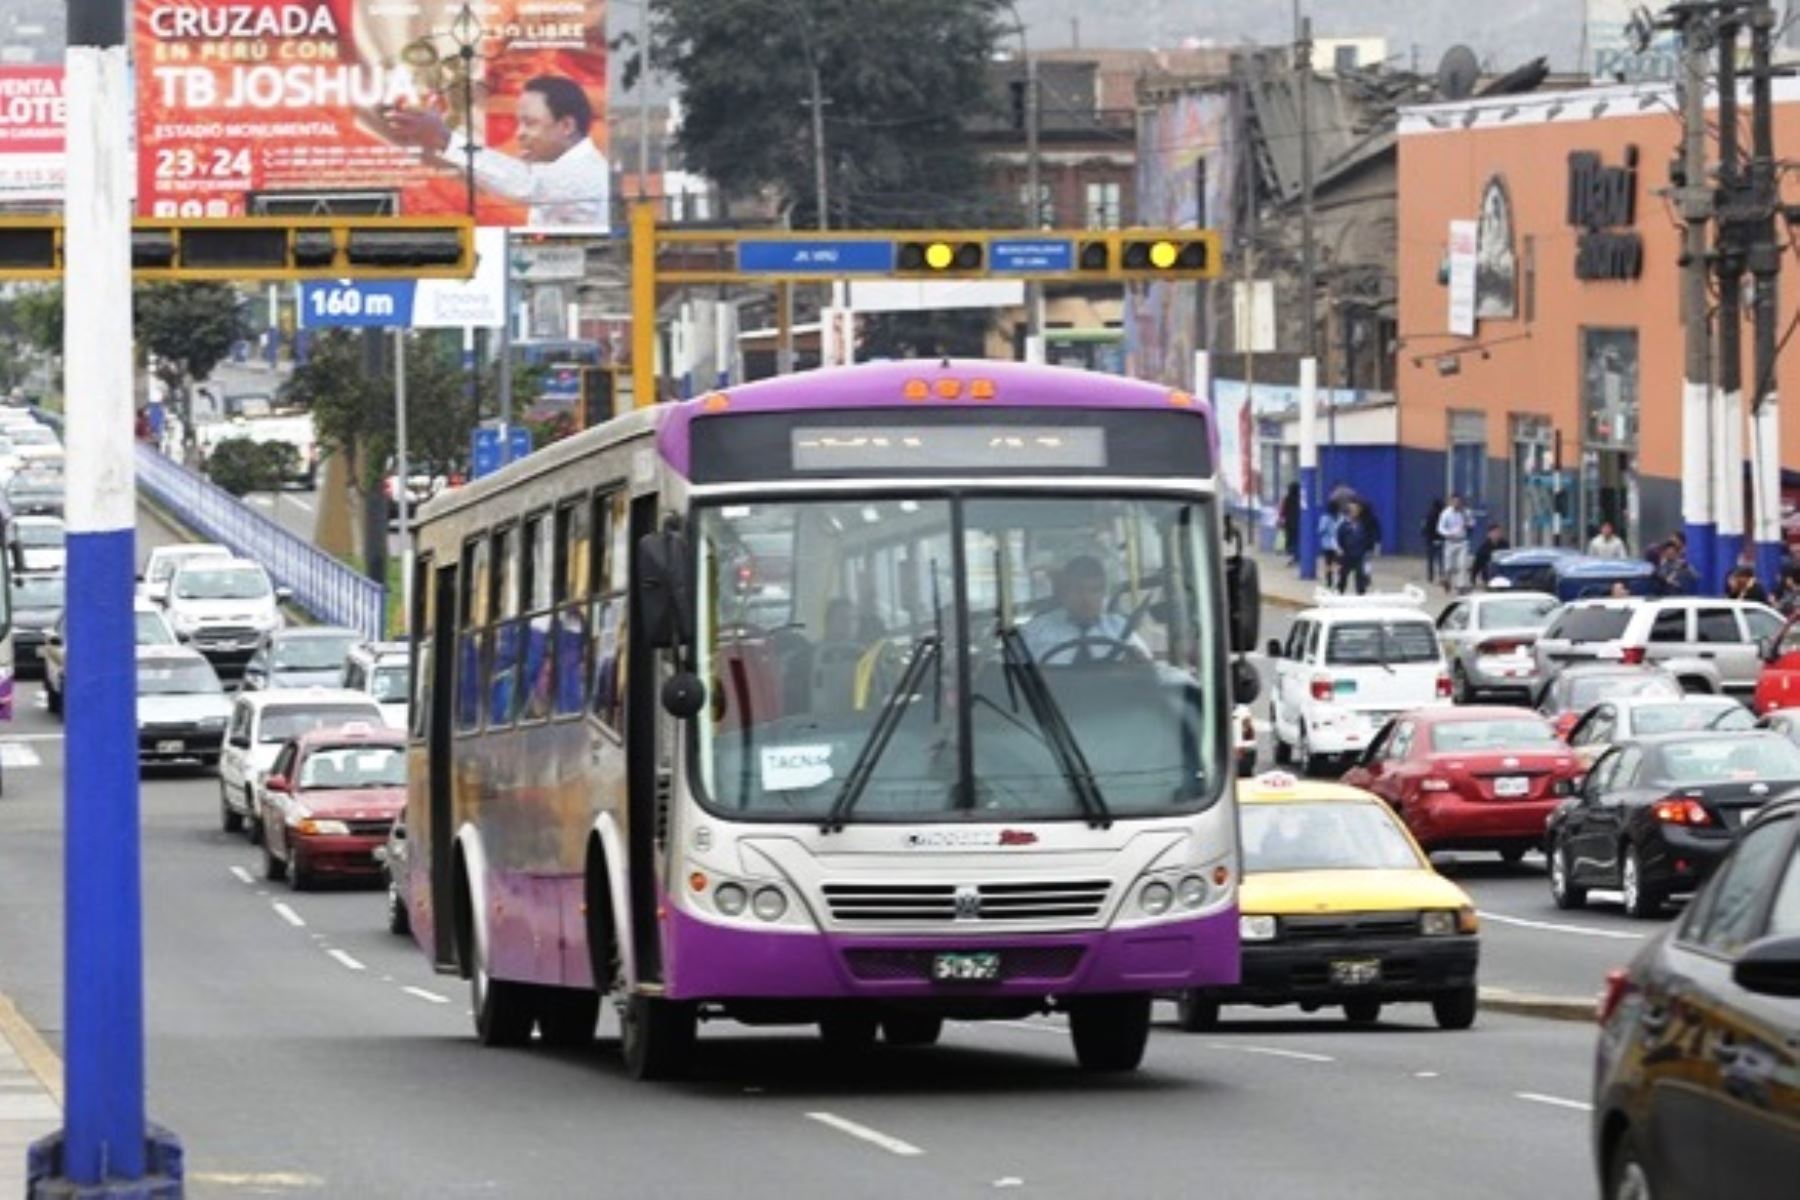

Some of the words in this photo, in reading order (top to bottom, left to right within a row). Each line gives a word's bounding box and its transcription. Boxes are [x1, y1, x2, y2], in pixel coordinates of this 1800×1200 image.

[151, 5, 337, 37] CRUZADA
[154, 41, 190, 61] EN
[201, 39, 268, 62] PERÚ
[278, 40, 339, 60] CON
[153, 66, 217, 108] TB
[223, 65, 421, 108] JOSHUA
[155, 124, 222, 138] ESTADIO
[156, 148, 196, 179] 23
[211, 148, 252, 178] 24
[311, 290, 361, 316] 160
[365, 292, 394, 316] m
